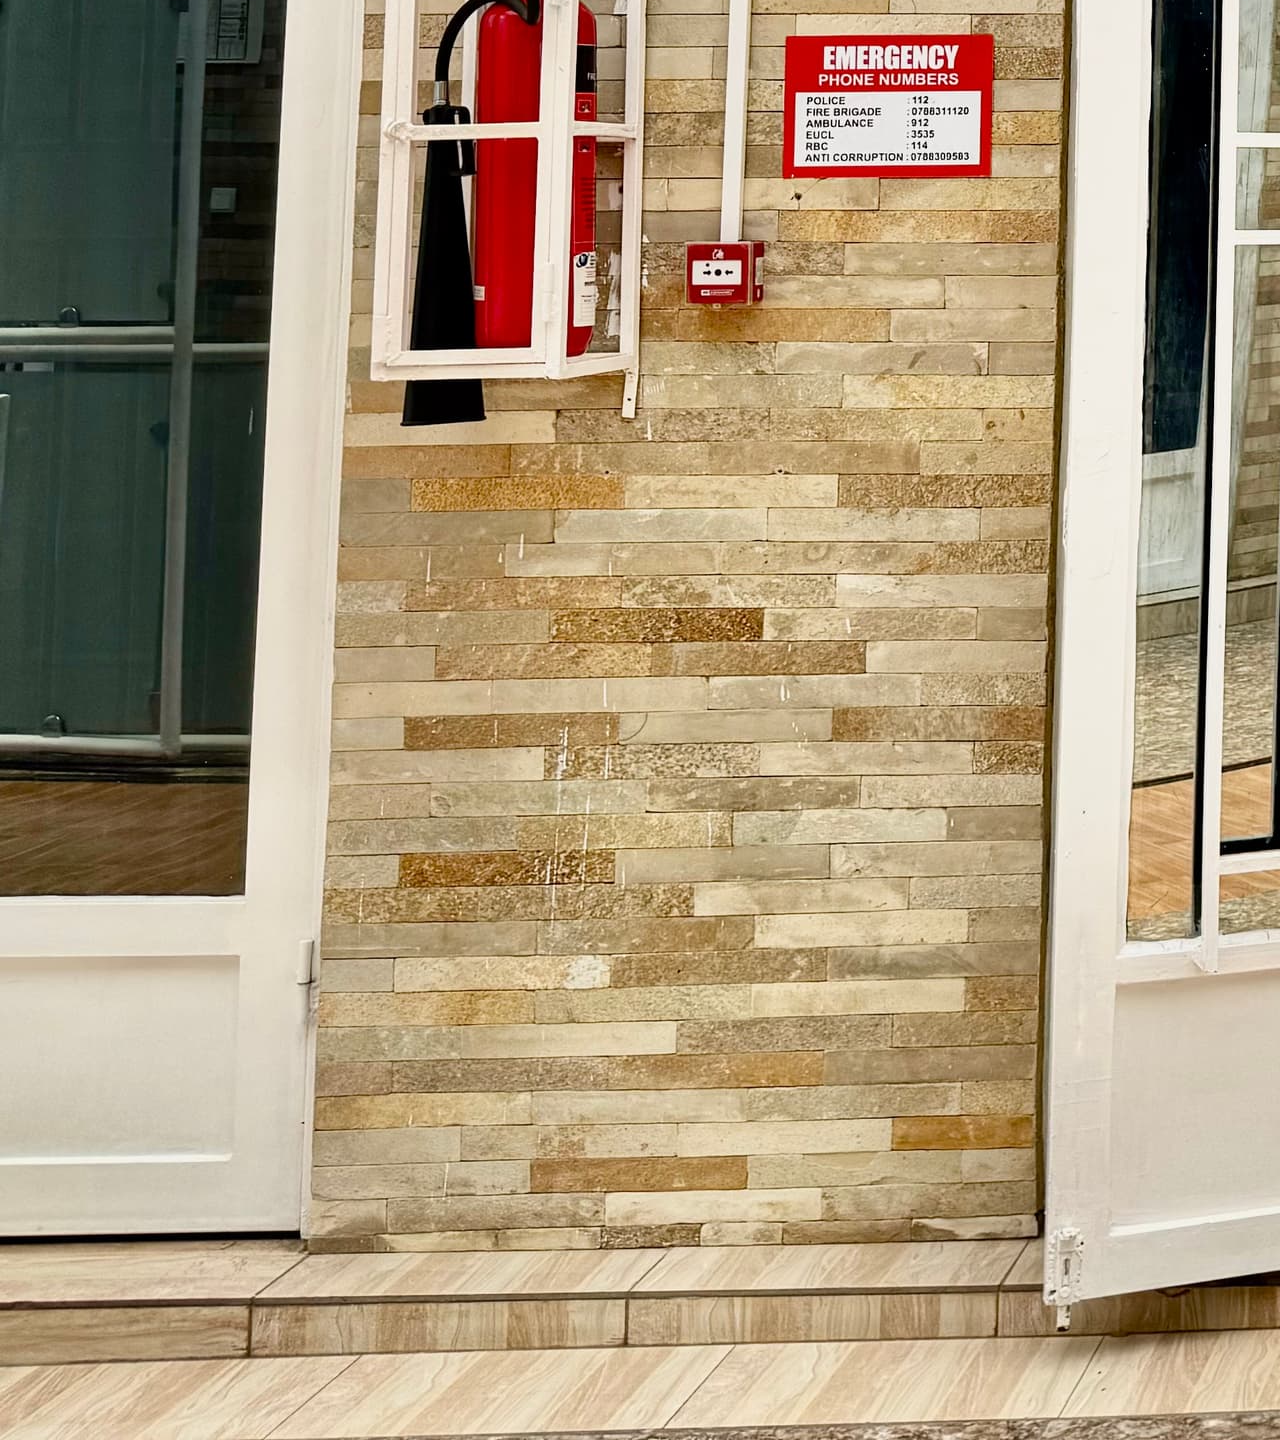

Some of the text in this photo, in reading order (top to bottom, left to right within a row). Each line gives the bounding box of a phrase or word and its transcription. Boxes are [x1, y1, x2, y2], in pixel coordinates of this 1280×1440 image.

[823, 44, 960, 71] EMERGENCY
[818, 72, 960, 86] PHONE NUMBERS
[806, 96, 846, 105] POLICE
[806, 108, 830, 117] FIRE
[833, 107, 882, 117] BRIGADE
[806, 119, 874, 128] AMBULANCE
[806, 131, 835, 140] EUCL
[805, 142, 828, 151] RBC
[805, 153, 830, 162] ANTI
[832, 152, 904, 162] CORRUPTION
